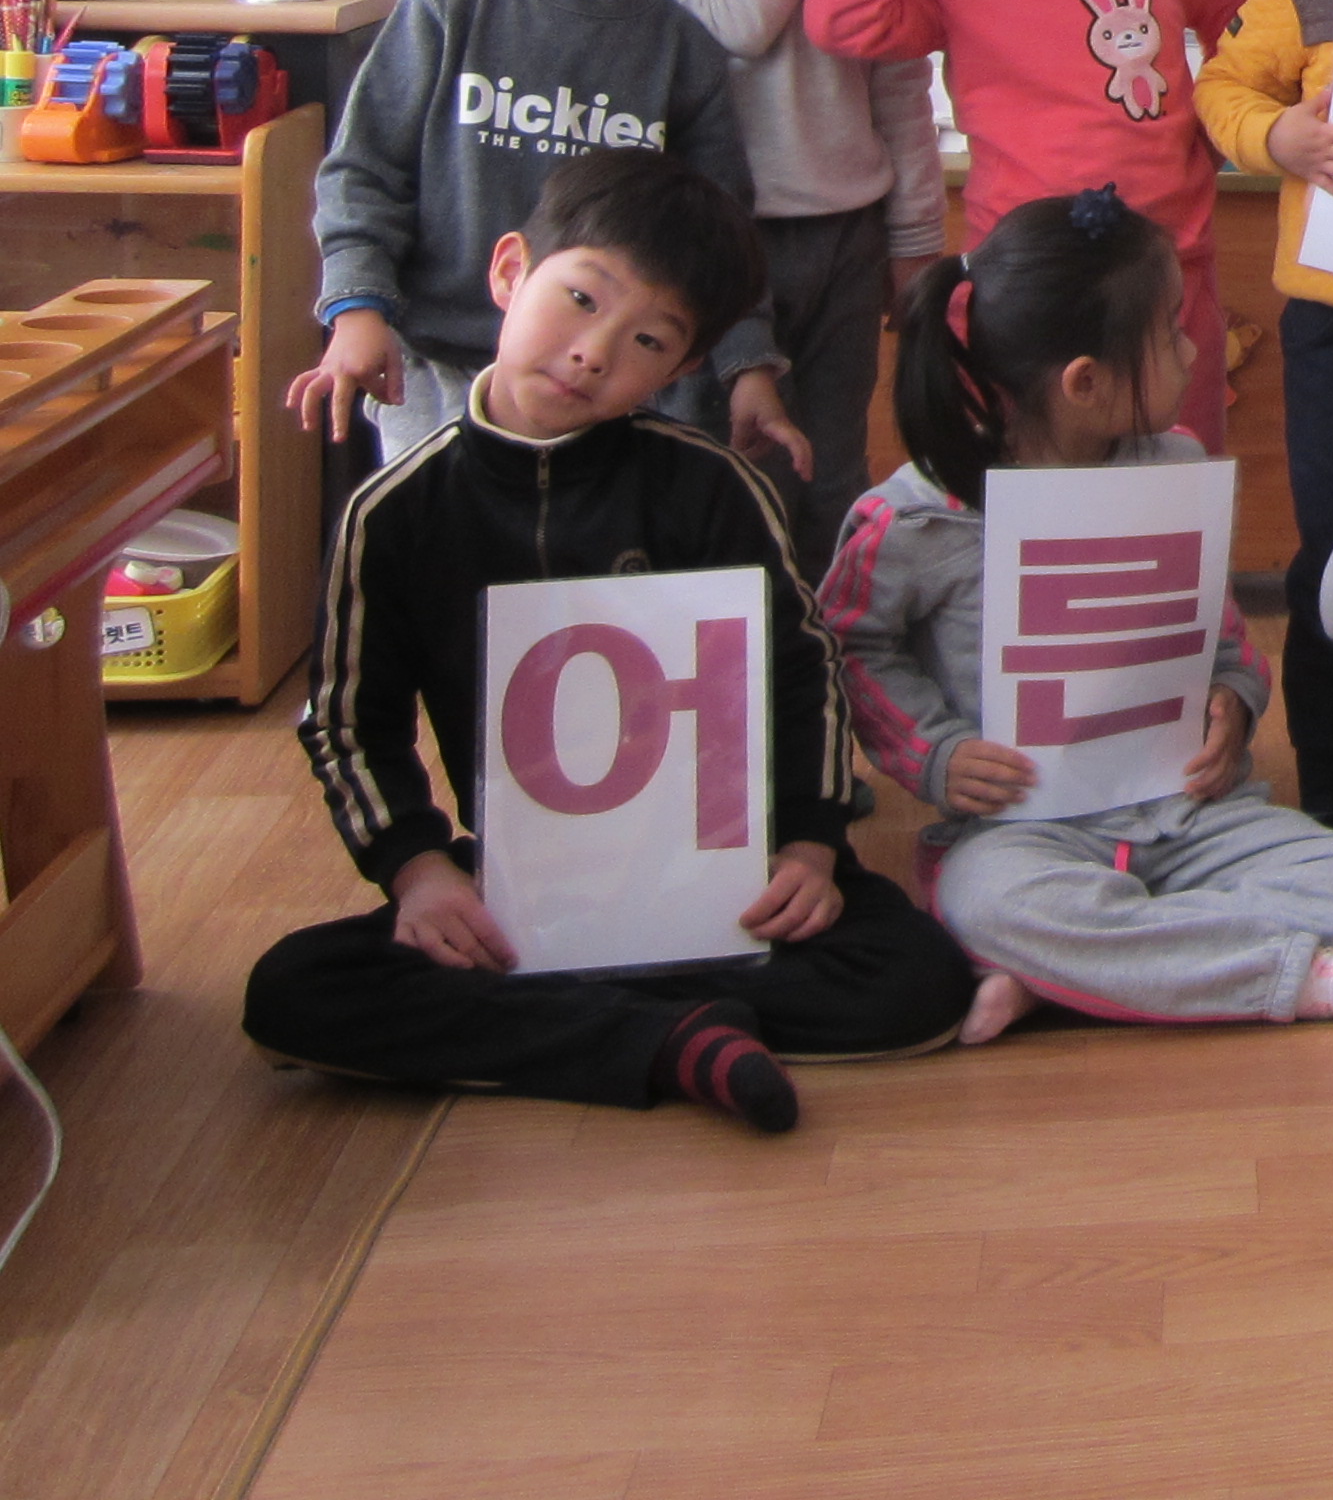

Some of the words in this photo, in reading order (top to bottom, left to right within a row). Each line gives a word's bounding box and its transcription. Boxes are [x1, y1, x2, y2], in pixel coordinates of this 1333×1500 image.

[458, 72, 666, 152] Dickies
[477, 130, 522, 150] THE
[1001, 530, 1205, 747] 른
[501, 617, 748, 850] 어
